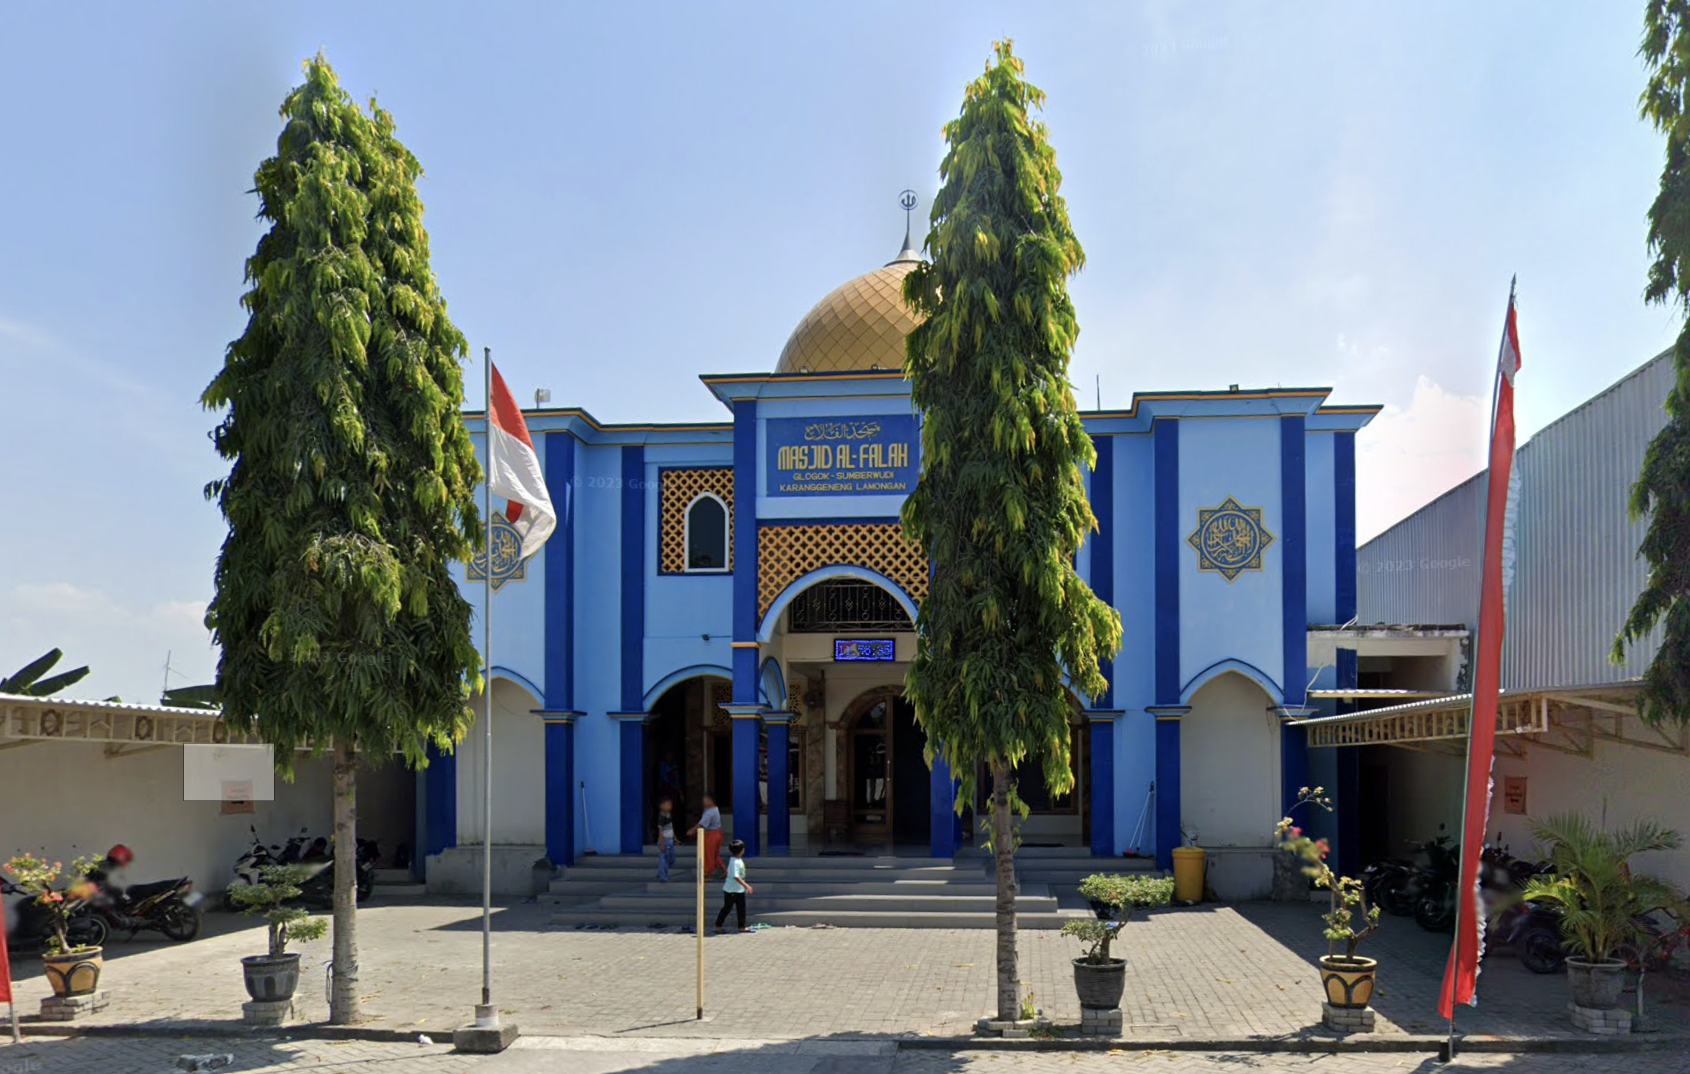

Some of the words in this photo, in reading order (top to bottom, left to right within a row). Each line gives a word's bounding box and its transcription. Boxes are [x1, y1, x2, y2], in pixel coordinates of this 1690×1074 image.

[777, 445, 833, 471] MASJID
[836, 443, 909, 469] AL-FALAH
[793, 472, 830, 481] GLOGOK
[836, 471, 895, 480] SUMBERWUDI
[779, 483, 853, 493] KARANGGENENG
[856, 482, 906, 491] LAMONGAN
